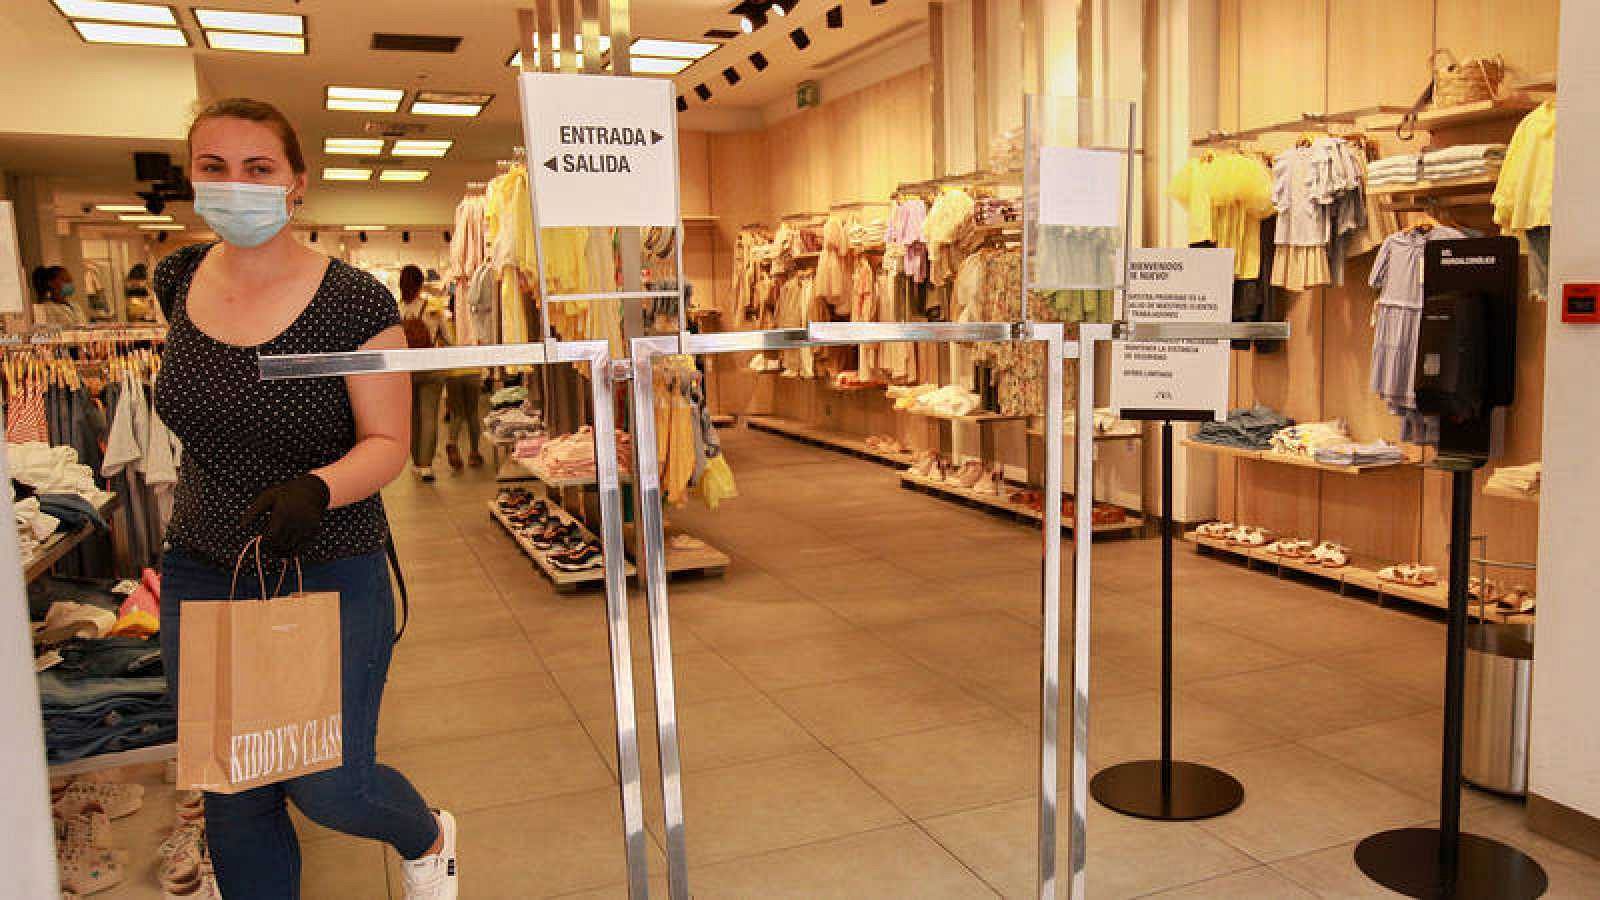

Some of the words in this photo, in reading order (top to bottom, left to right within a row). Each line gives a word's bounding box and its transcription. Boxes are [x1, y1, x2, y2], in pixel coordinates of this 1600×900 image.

[560, 126, 647, 145] ENTRADA
[563, 153, 631, 172] SALIDA
[231, 725, 298, 784] KIDDY'S
